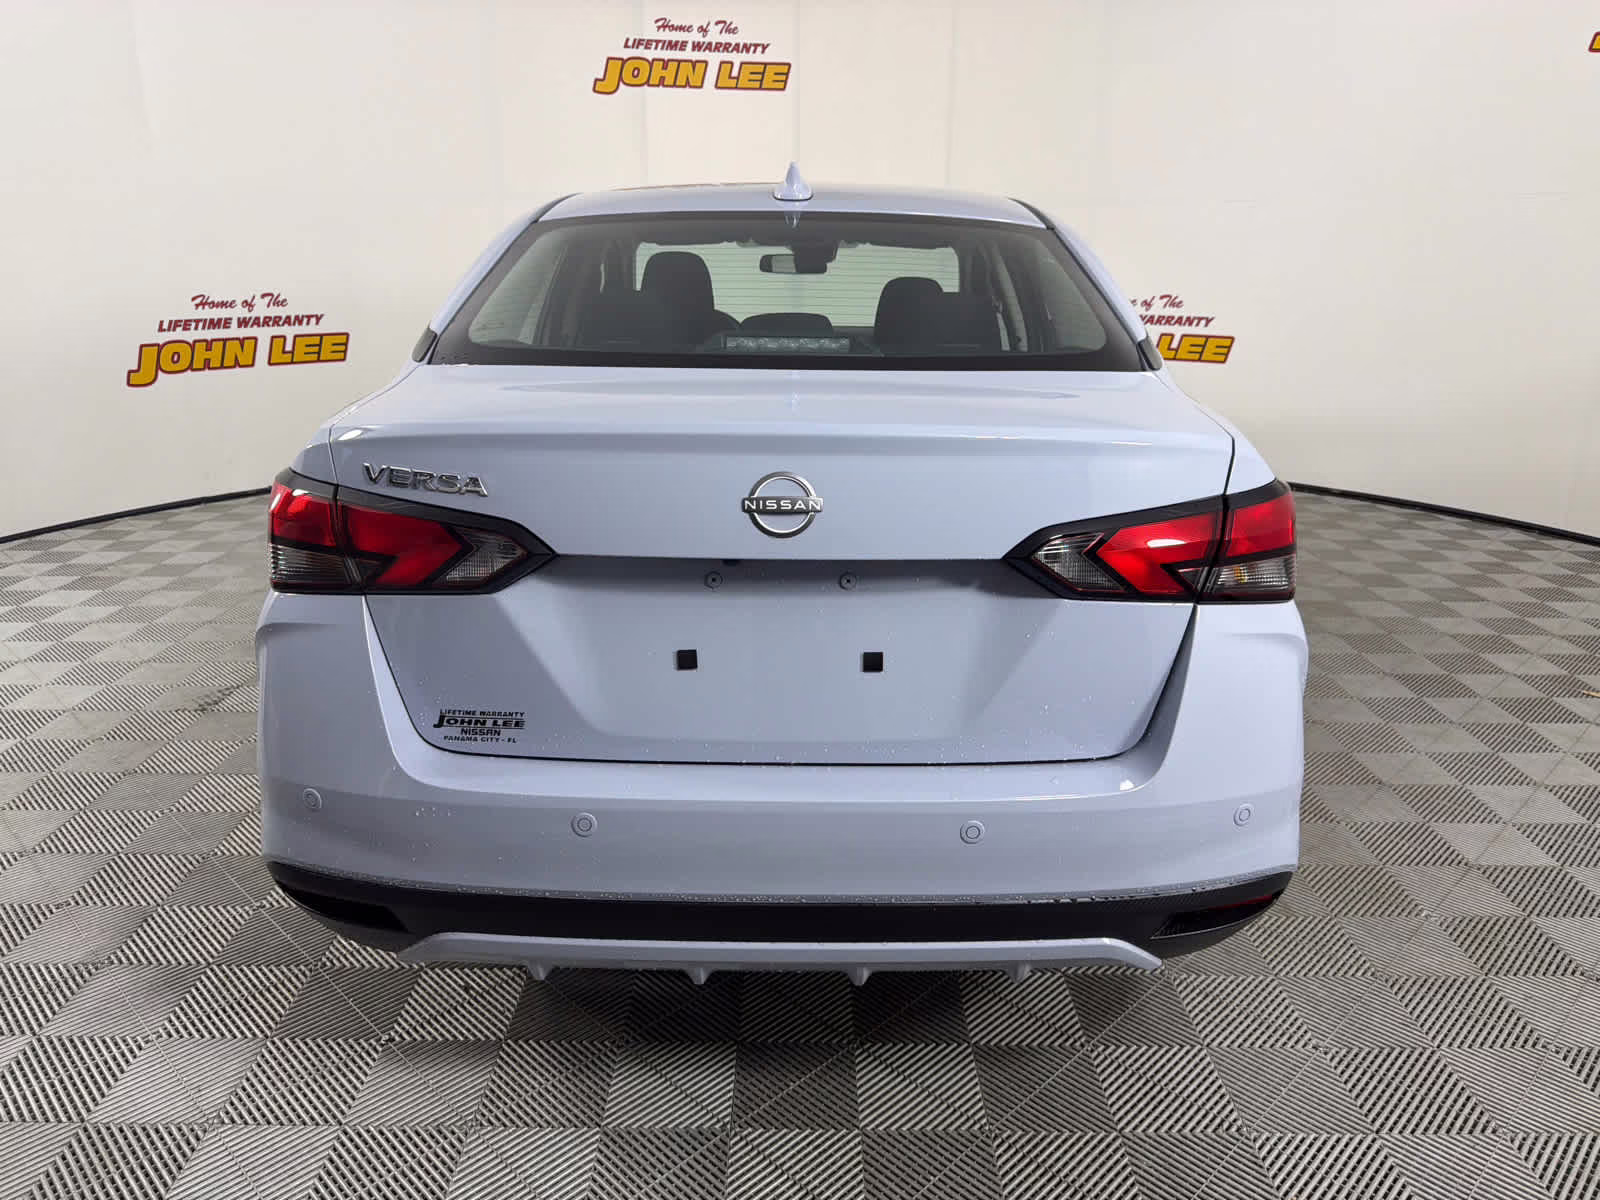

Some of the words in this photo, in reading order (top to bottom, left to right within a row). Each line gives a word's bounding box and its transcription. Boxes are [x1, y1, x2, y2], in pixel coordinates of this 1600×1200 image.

[654, 17, 694, 33] Home
[697, 21, 711, 37] of
[714, 20, 739, 35] The
[623, 38, 688, 51] LIFETIME
[691, 40, 770, 54] WARRANTY
[592, 56, 708, 95] JOHN
[714, 61, 791, 91] LEE
[191, 294, 237, 310] Home
[241, 295, 256, 313] of
[260, 293, 289, 308] The
[1140, 296, 1155, 312] of
[1159, 294, 1184, 309] The
[157, 317, 232, 332] LIFETIME
[237, 314, 324, 329] WARRANTY
[1156, 333, 1235, 364] LEE
[126, 336, 258, 387] JOHN
[267, 332, 350, 366] LEE
[362, 462, 489, 498] VERSA
[744, 499, 821, 511] NISSAN
[433, 714, 487, 728] JOHN
[460, 728, 501, 736] NISSAN
